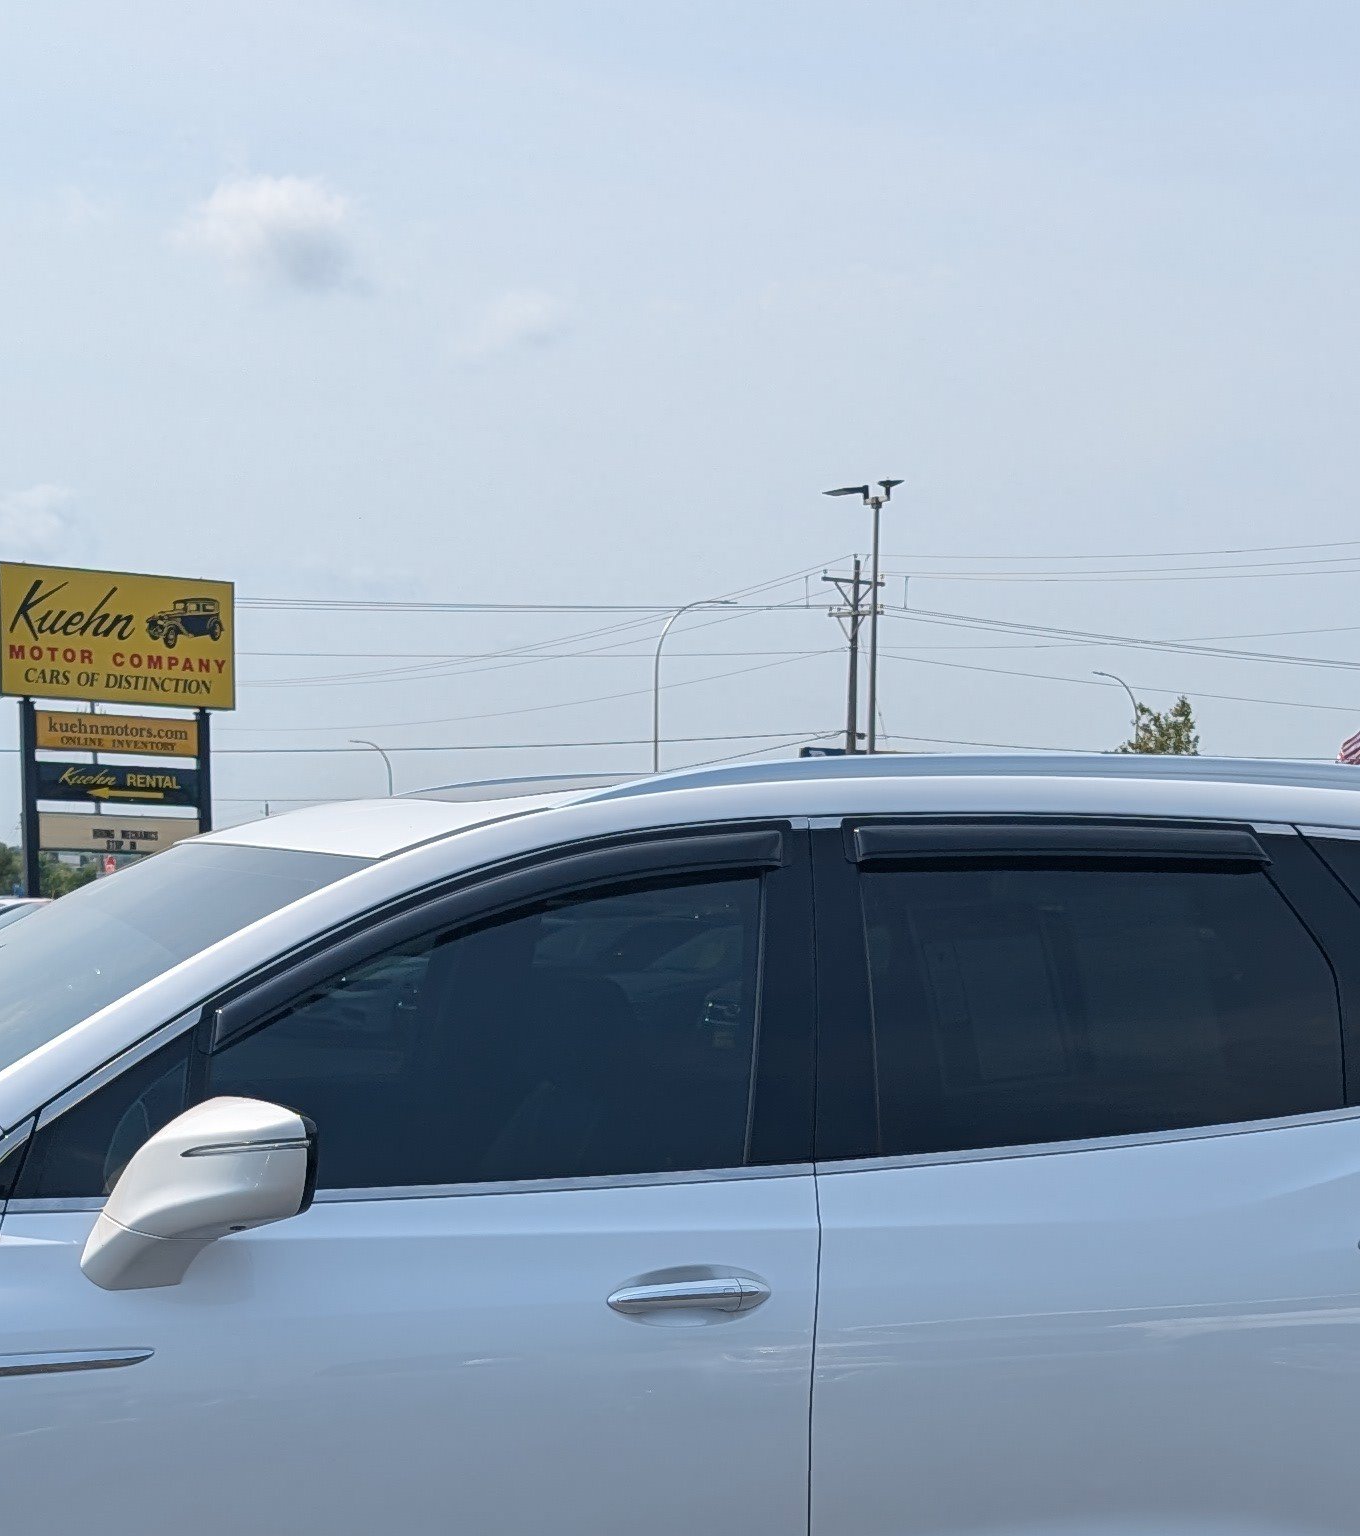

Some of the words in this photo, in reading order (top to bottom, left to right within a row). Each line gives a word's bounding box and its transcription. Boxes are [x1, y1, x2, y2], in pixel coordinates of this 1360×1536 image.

[9, 579, 136, 642] Kuehn
[9, 644, 94, 665] MOTOR
[112, 652, 226, 674] COMPANY
[24, 667, 71, 686] CARS
[77, 671, 100, 687] OF
[105, 673, 213, 695] DISTINCTION
[48, 716, 188, 741] kuehnmotors.com
[60, 736, 104, 747] ONLINE
[112, 739, 177, 751] INVENTORY
[58, 766, 117, 786] Kuehn
[126, 773, 182, 789] RENTAL
